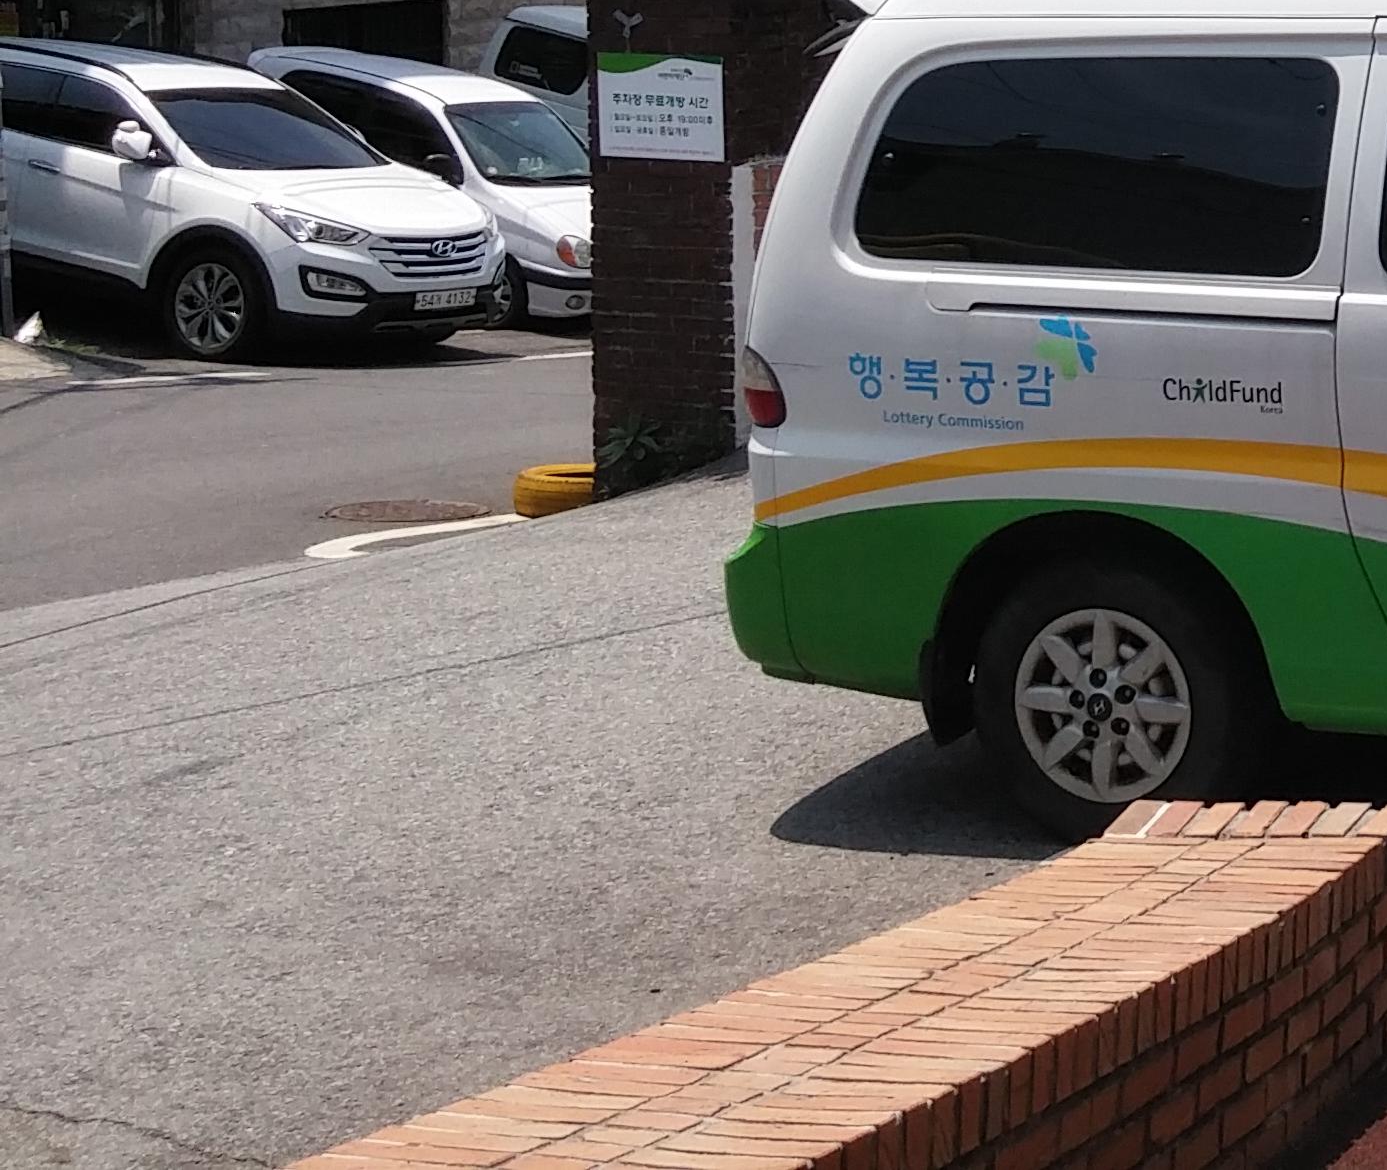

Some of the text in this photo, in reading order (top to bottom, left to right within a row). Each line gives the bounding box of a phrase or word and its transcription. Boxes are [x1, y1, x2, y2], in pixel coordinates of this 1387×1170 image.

[612, 93, 708, 109] 주차장 무료개방 시간
[658, 113, 673, 122] 오후
[446, 291, 472, 304] 4132
[883, 409, 1025, 430] Lottery Commission
